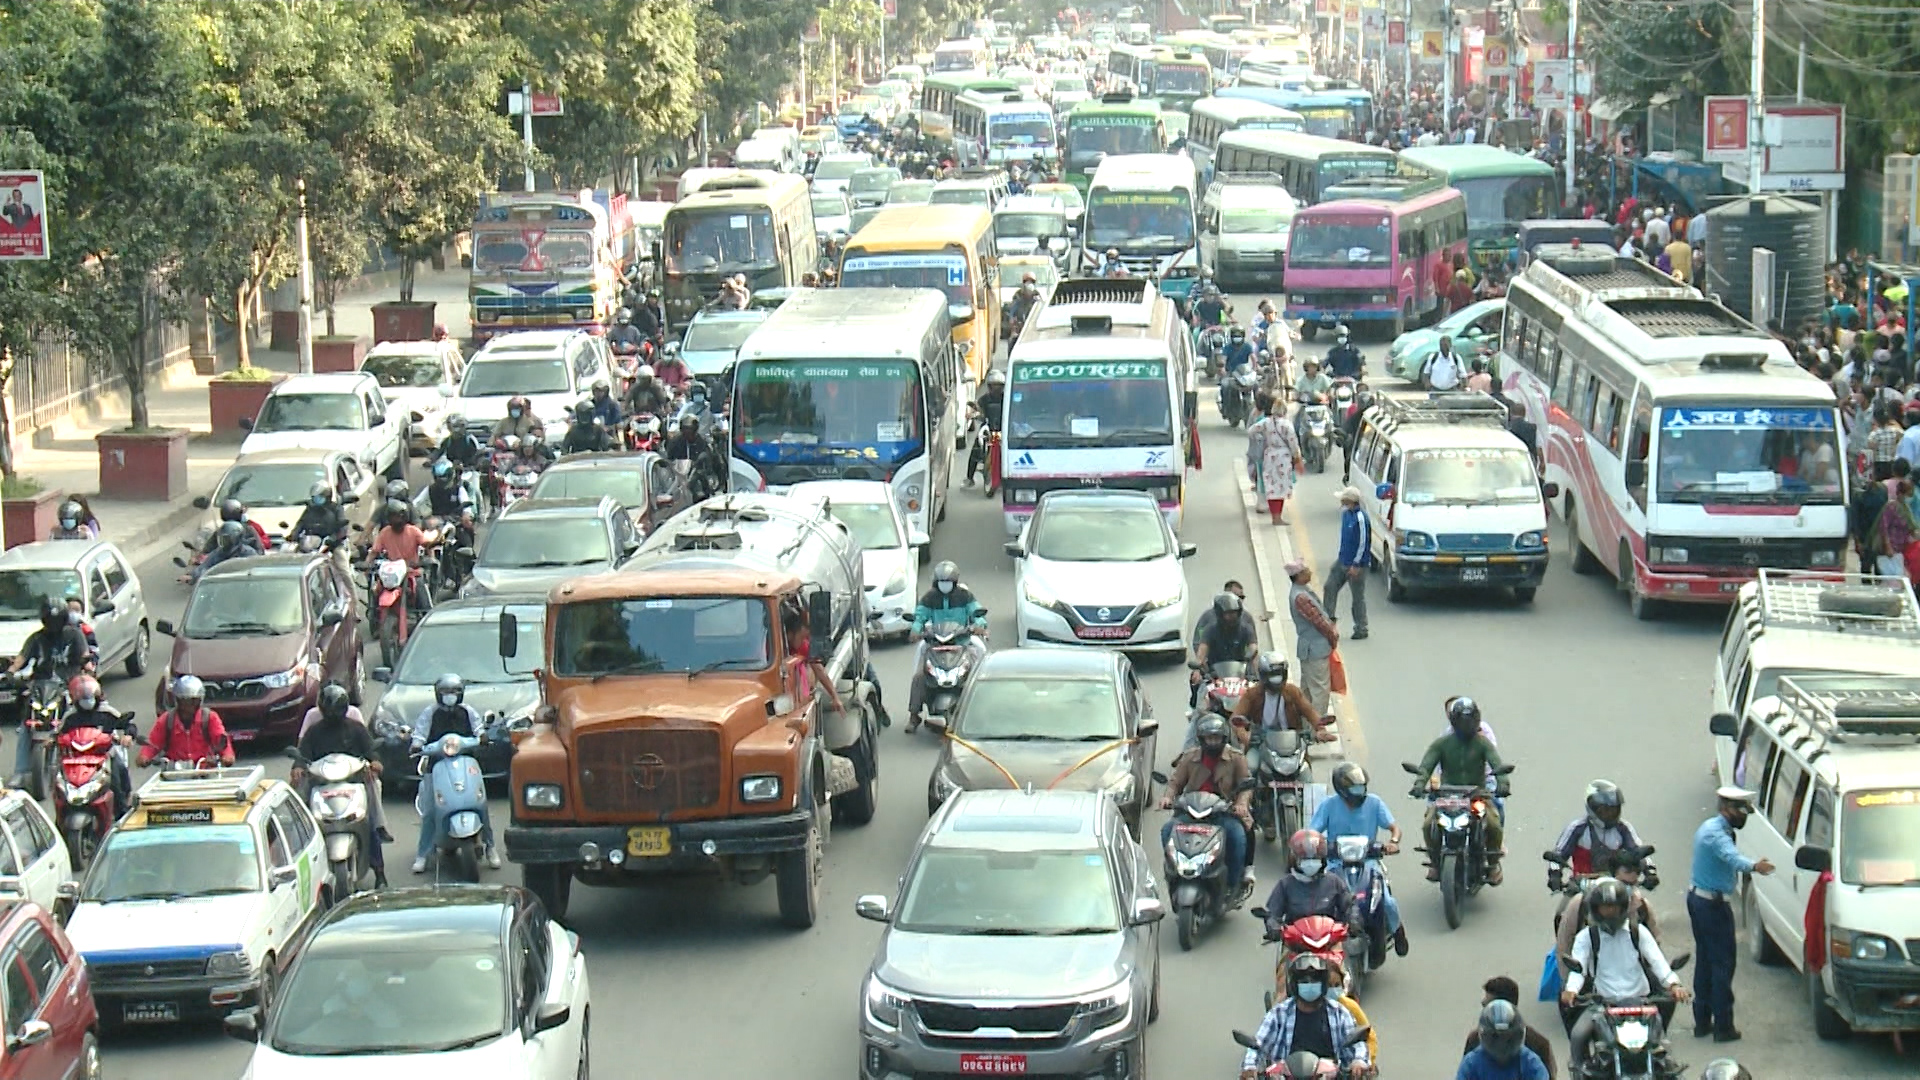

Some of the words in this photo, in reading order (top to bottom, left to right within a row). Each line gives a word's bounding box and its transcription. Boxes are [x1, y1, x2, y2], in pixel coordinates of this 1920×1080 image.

[1109, 117, 1151, 126] YATAYAT
[1032, 363, 1146, 378] TOURIST
[1691, 410, 1737, 424] जय
[1430, 449, 1503, 459] TOYOTA
[816, 467, 839, 475] TATA
[1739, 537, 1765, 545] TATA
